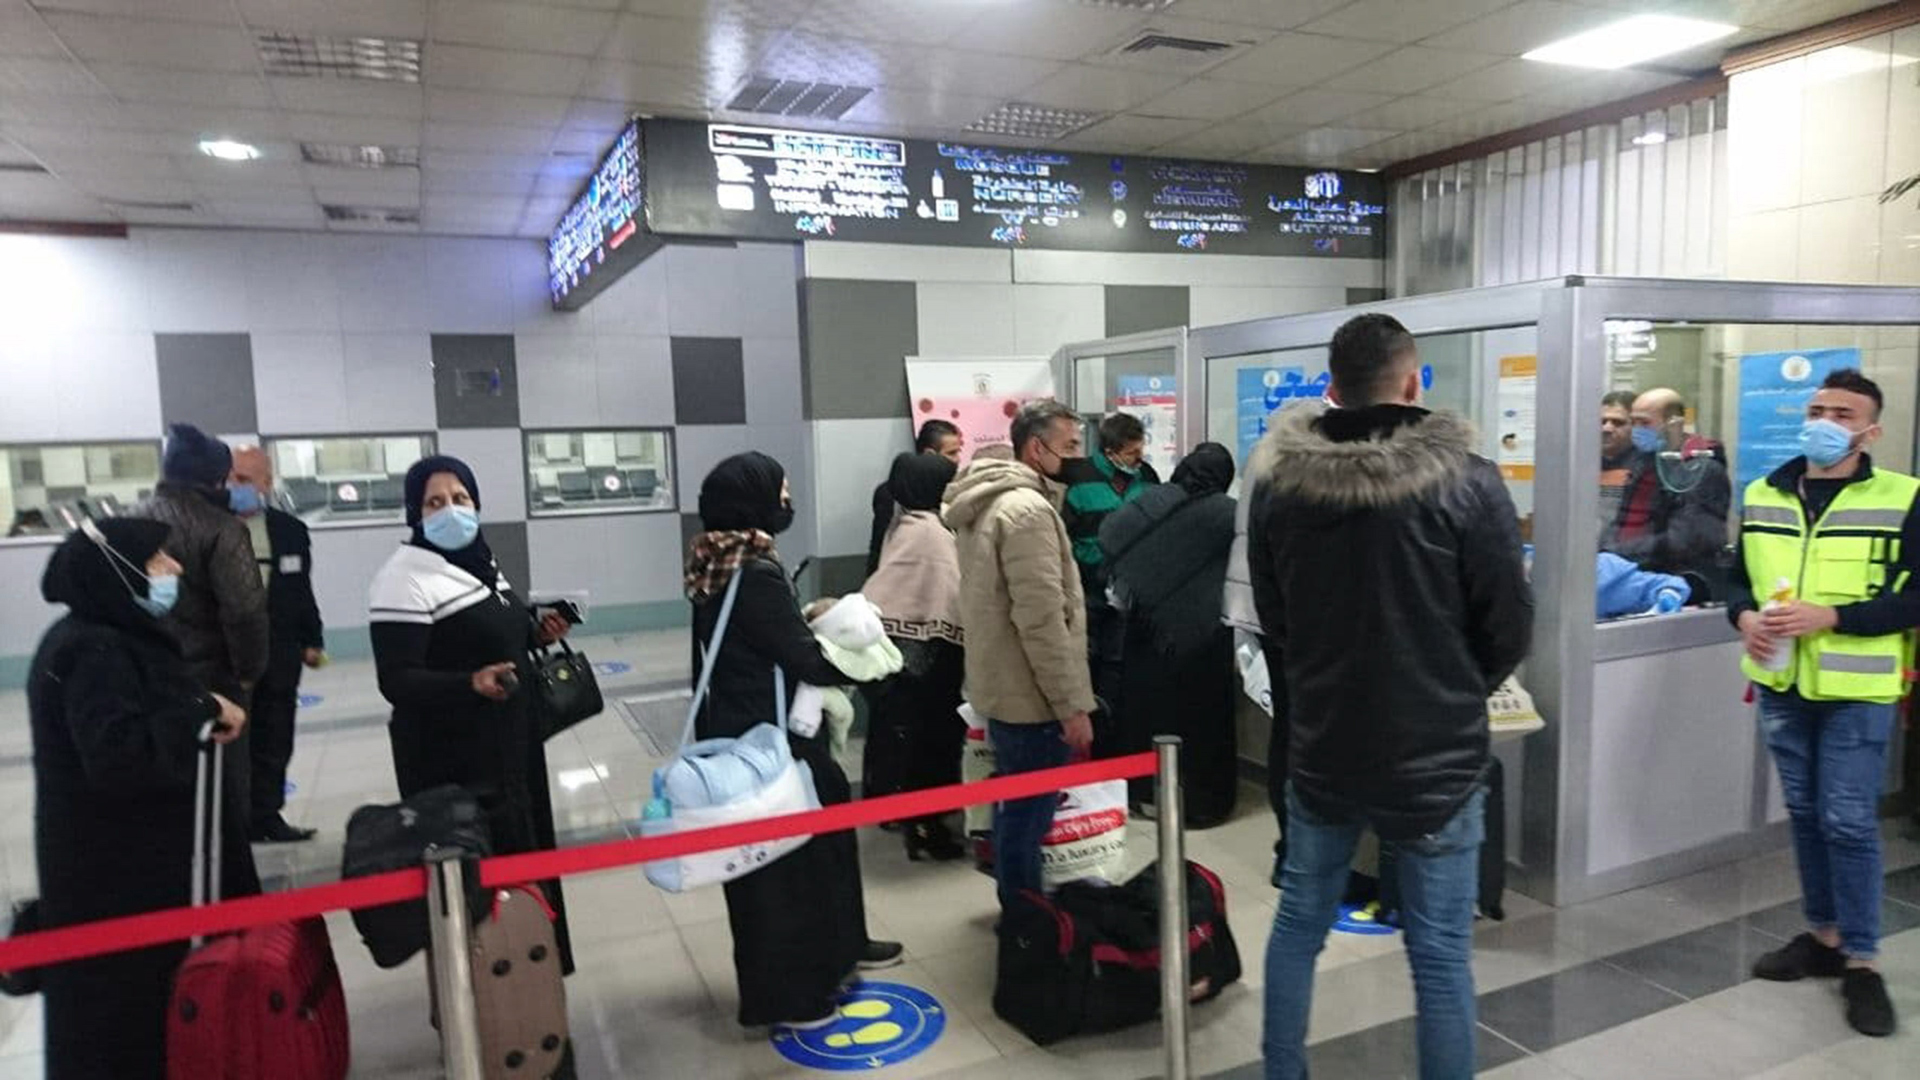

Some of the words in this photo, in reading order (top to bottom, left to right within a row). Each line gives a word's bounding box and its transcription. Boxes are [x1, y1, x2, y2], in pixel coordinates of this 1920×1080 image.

[774, 200, 900, 219] INFORMATION
[1292, 211, 1360, 223] ALEPPO
[1279, 223, 1324, 235] DUTY
